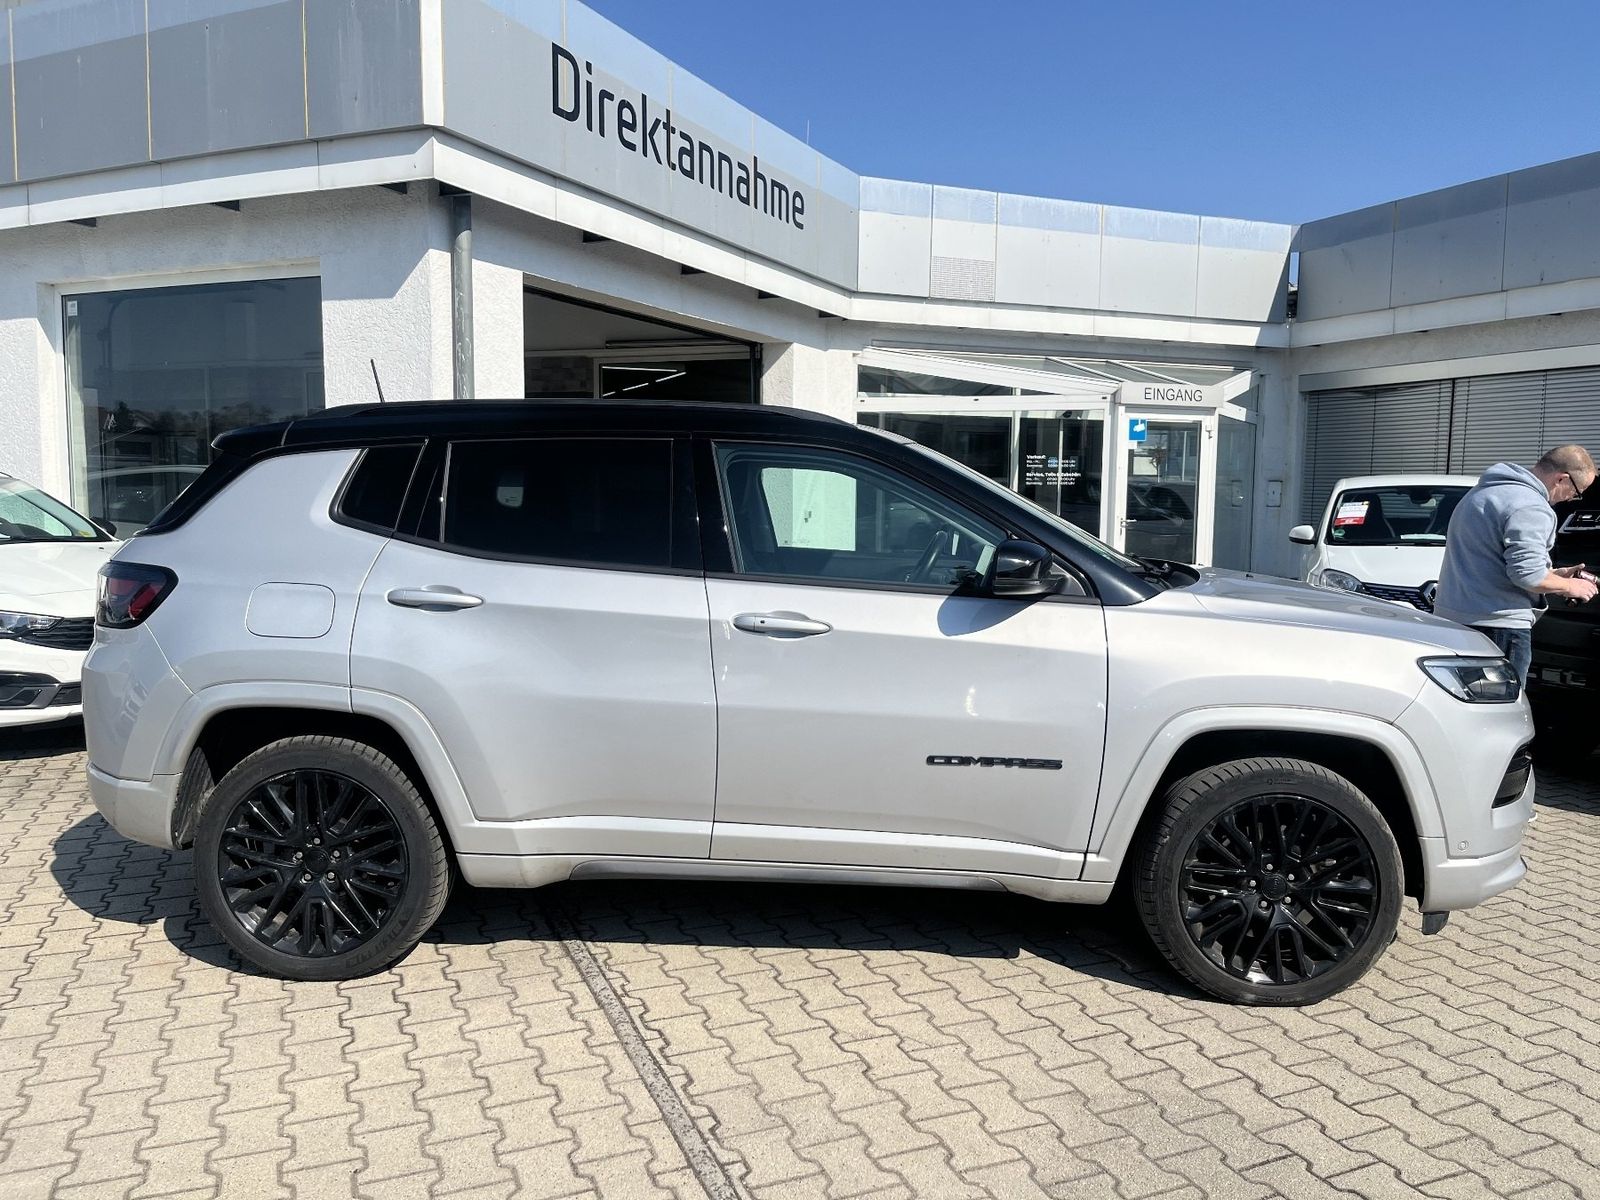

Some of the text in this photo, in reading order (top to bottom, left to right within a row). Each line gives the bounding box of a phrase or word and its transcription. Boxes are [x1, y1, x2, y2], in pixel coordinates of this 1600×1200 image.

[551, 41, 805, 230] Direktannahme
[1144, 387, 1203, 402] EINGANG
[926, 755, 1063, 770] COMPASS
